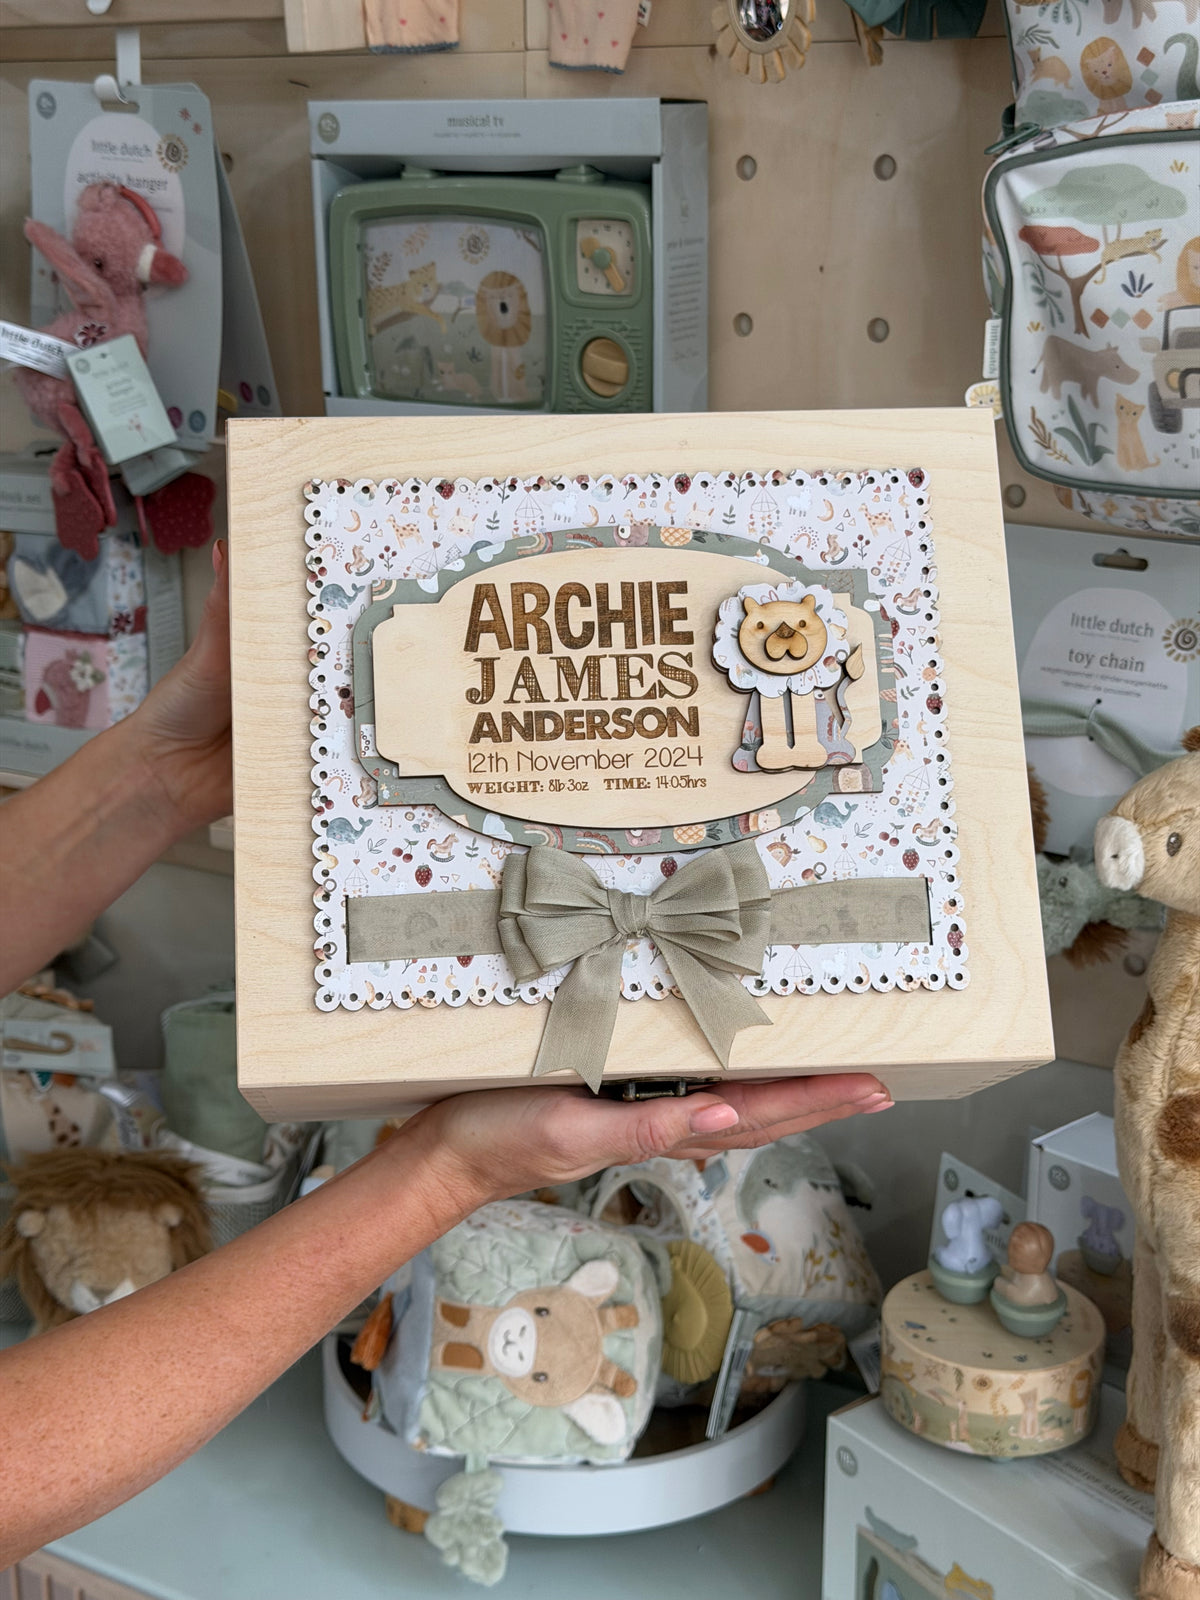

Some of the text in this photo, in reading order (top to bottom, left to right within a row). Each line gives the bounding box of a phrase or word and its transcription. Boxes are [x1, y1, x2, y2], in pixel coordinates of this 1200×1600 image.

[464, 581, 694, 654] ARCHIE
[1070, 612, 1106, 632] little
[1108, 618, 1155, 638] dutch
[1068, 648, 1145, 673] toy chain
[465, 651, 699, 705] JAMES
[468, 706, 700, 744] ANDERSON
[467, 745, 703, 774] 12th November 2024
[467, 780, 544, 795] WEIGHT:
[603, 777, 651, 791] TIME:
